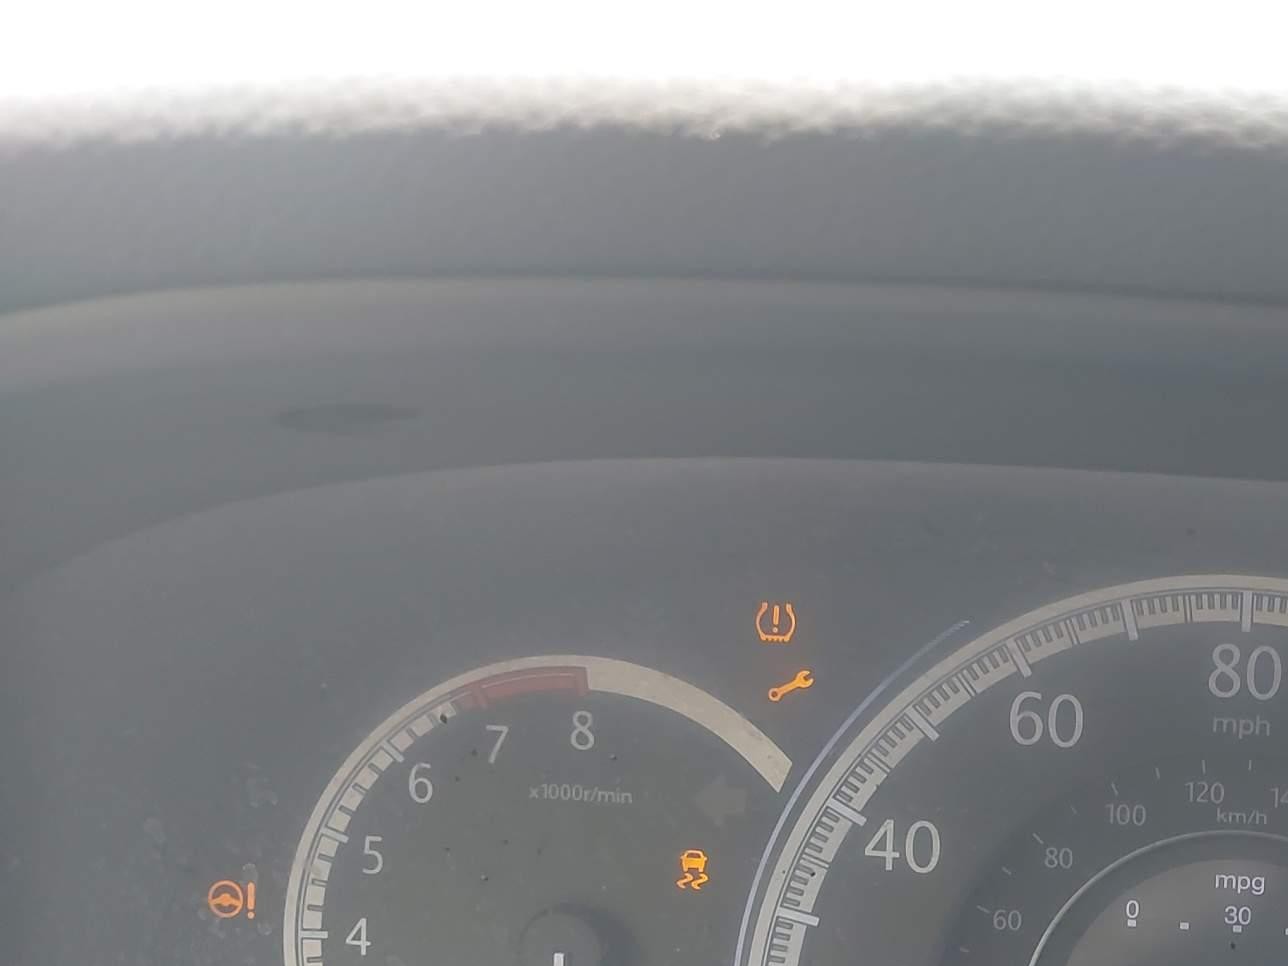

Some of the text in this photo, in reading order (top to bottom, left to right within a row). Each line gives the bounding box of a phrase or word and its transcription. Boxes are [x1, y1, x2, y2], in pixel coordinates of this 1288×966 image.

[1208, 643, 1282, 700] 80
[570, 710, 595, 751] 8
[1009, 691, 1084, 748] 60
[1212, 715, 1271, 738] mph
[485, 724, 509, 764] 7
[408, 762, 433, 804] 6
[529, 783, 633, 804] x1000r/min
[1185, 781, 1225, 804] 120
[1105, 803, 1147, 826] 100
[1216, 807, 1267, 825] km/h
[362, 835, 383, 875] 5
[863, 817, 941, 874] 40
[1044, 847, 1073, 869] 80
[1215, 873, 1265, 895] mpg
[993, 909, 1022, 931] 60
[1126, 901, 1140, 918] 0
[1224, 905, 1252, 925] 30
[345, 917, 372, 956] 4
